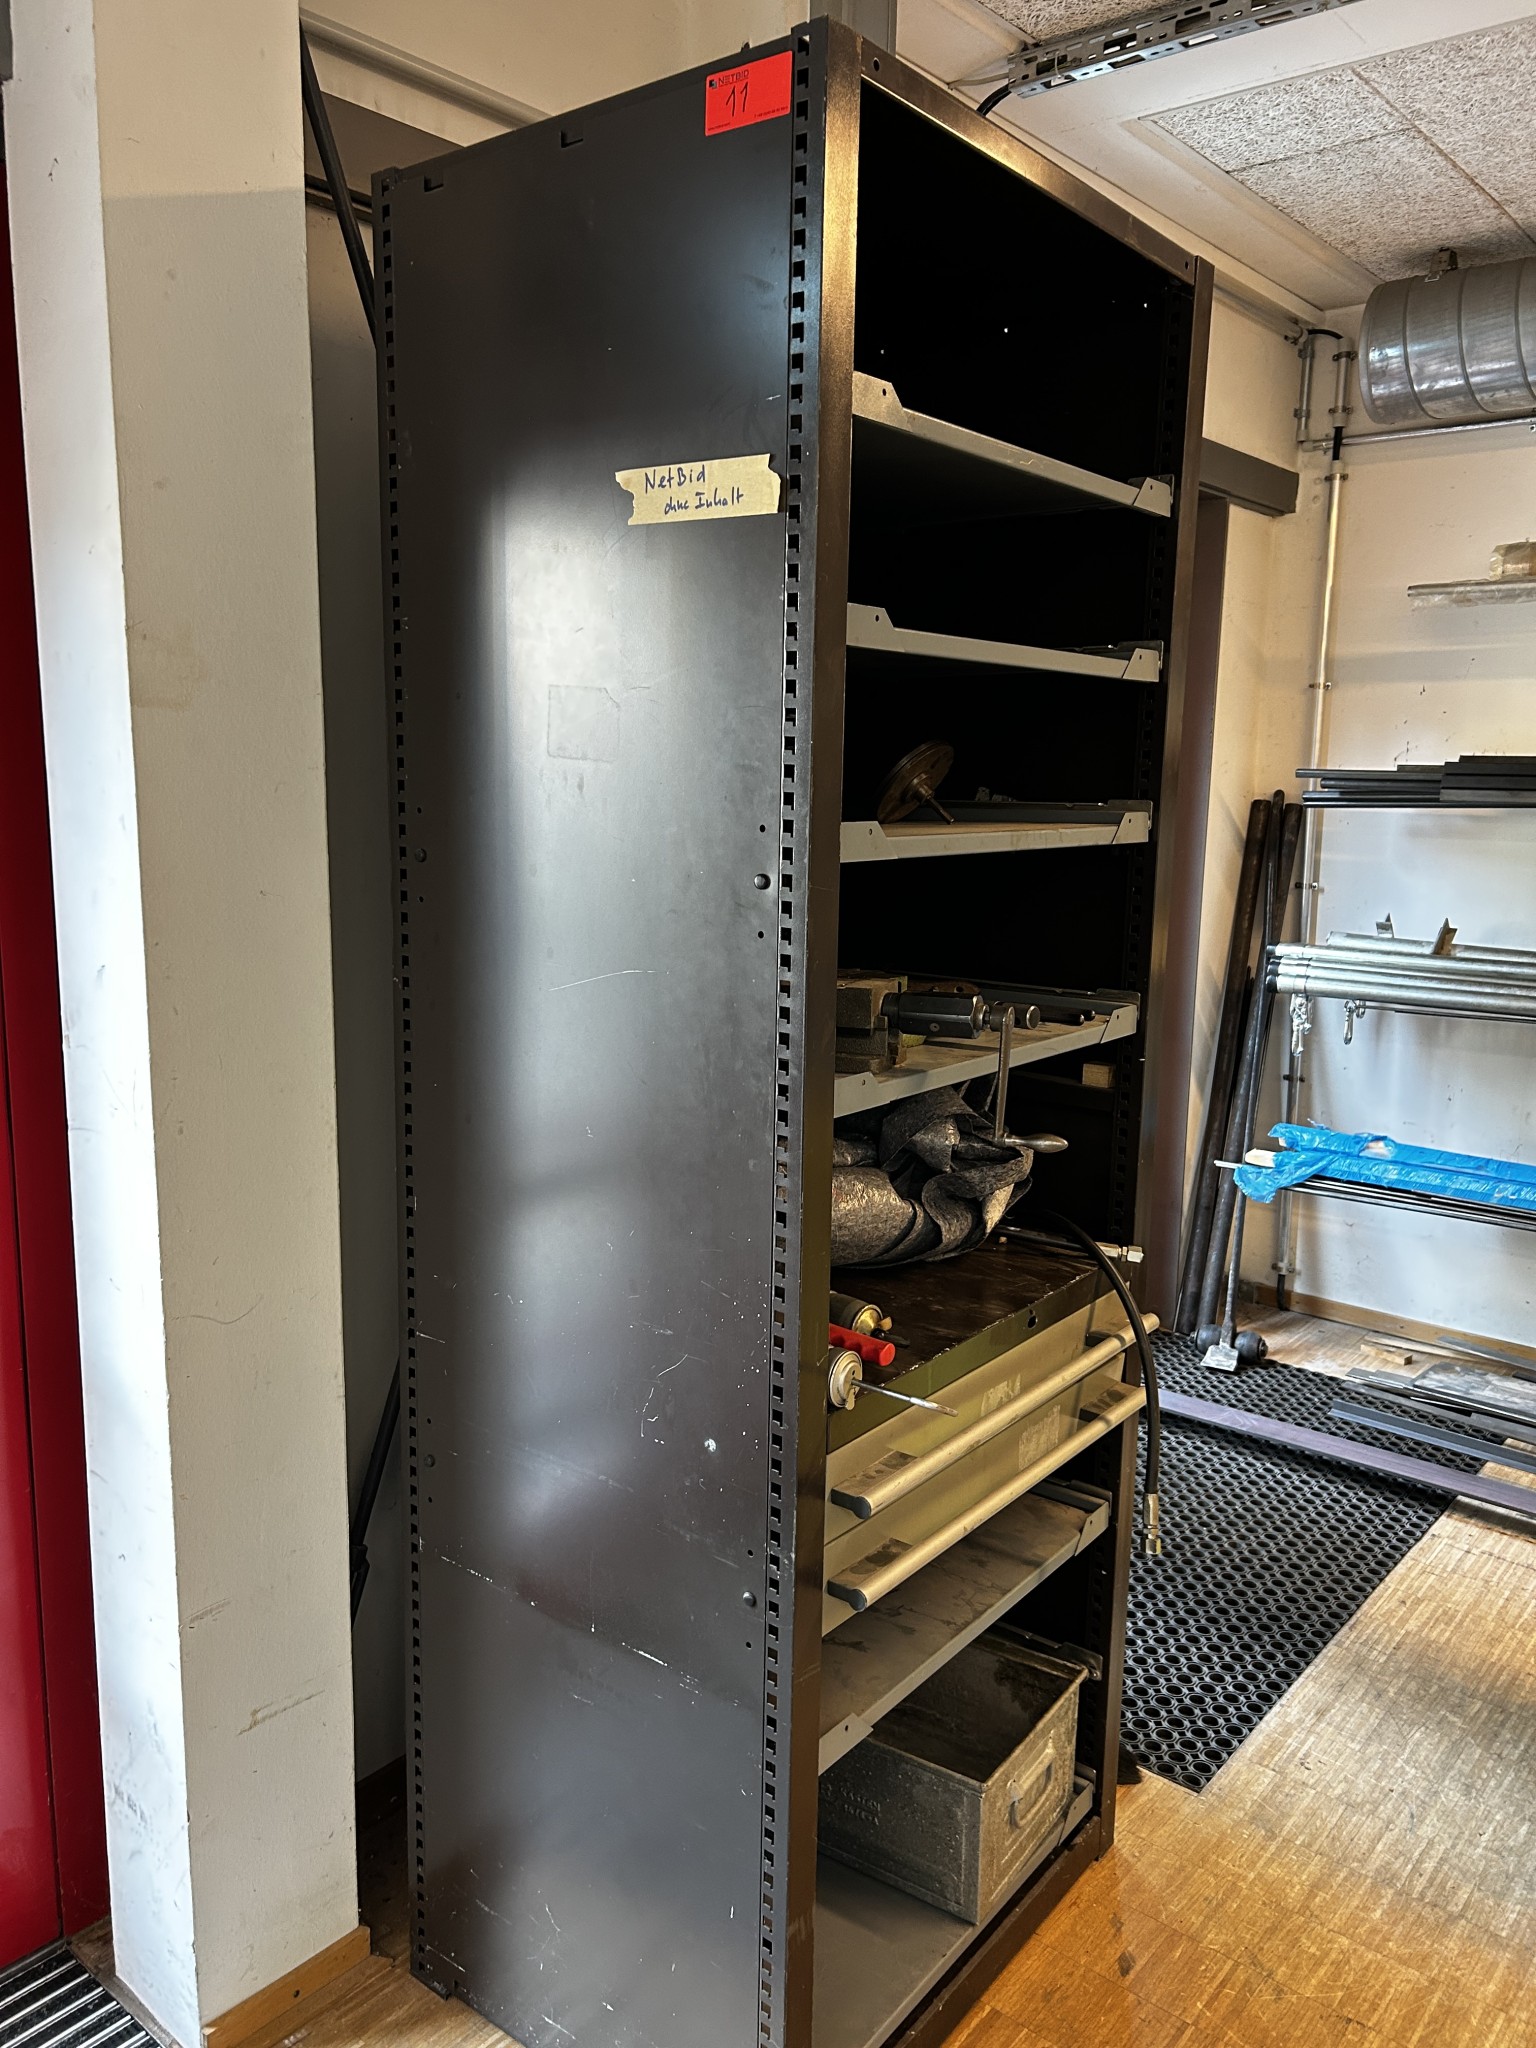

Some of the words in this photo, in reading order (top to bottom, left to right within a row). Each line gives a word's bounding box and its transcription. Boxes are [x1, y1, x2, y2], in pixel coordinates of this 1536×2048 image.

[718, 70, 749, 84] NETBID
[726, 82, 748, 116] 11
[644, 464, 706, 494] NetBid
